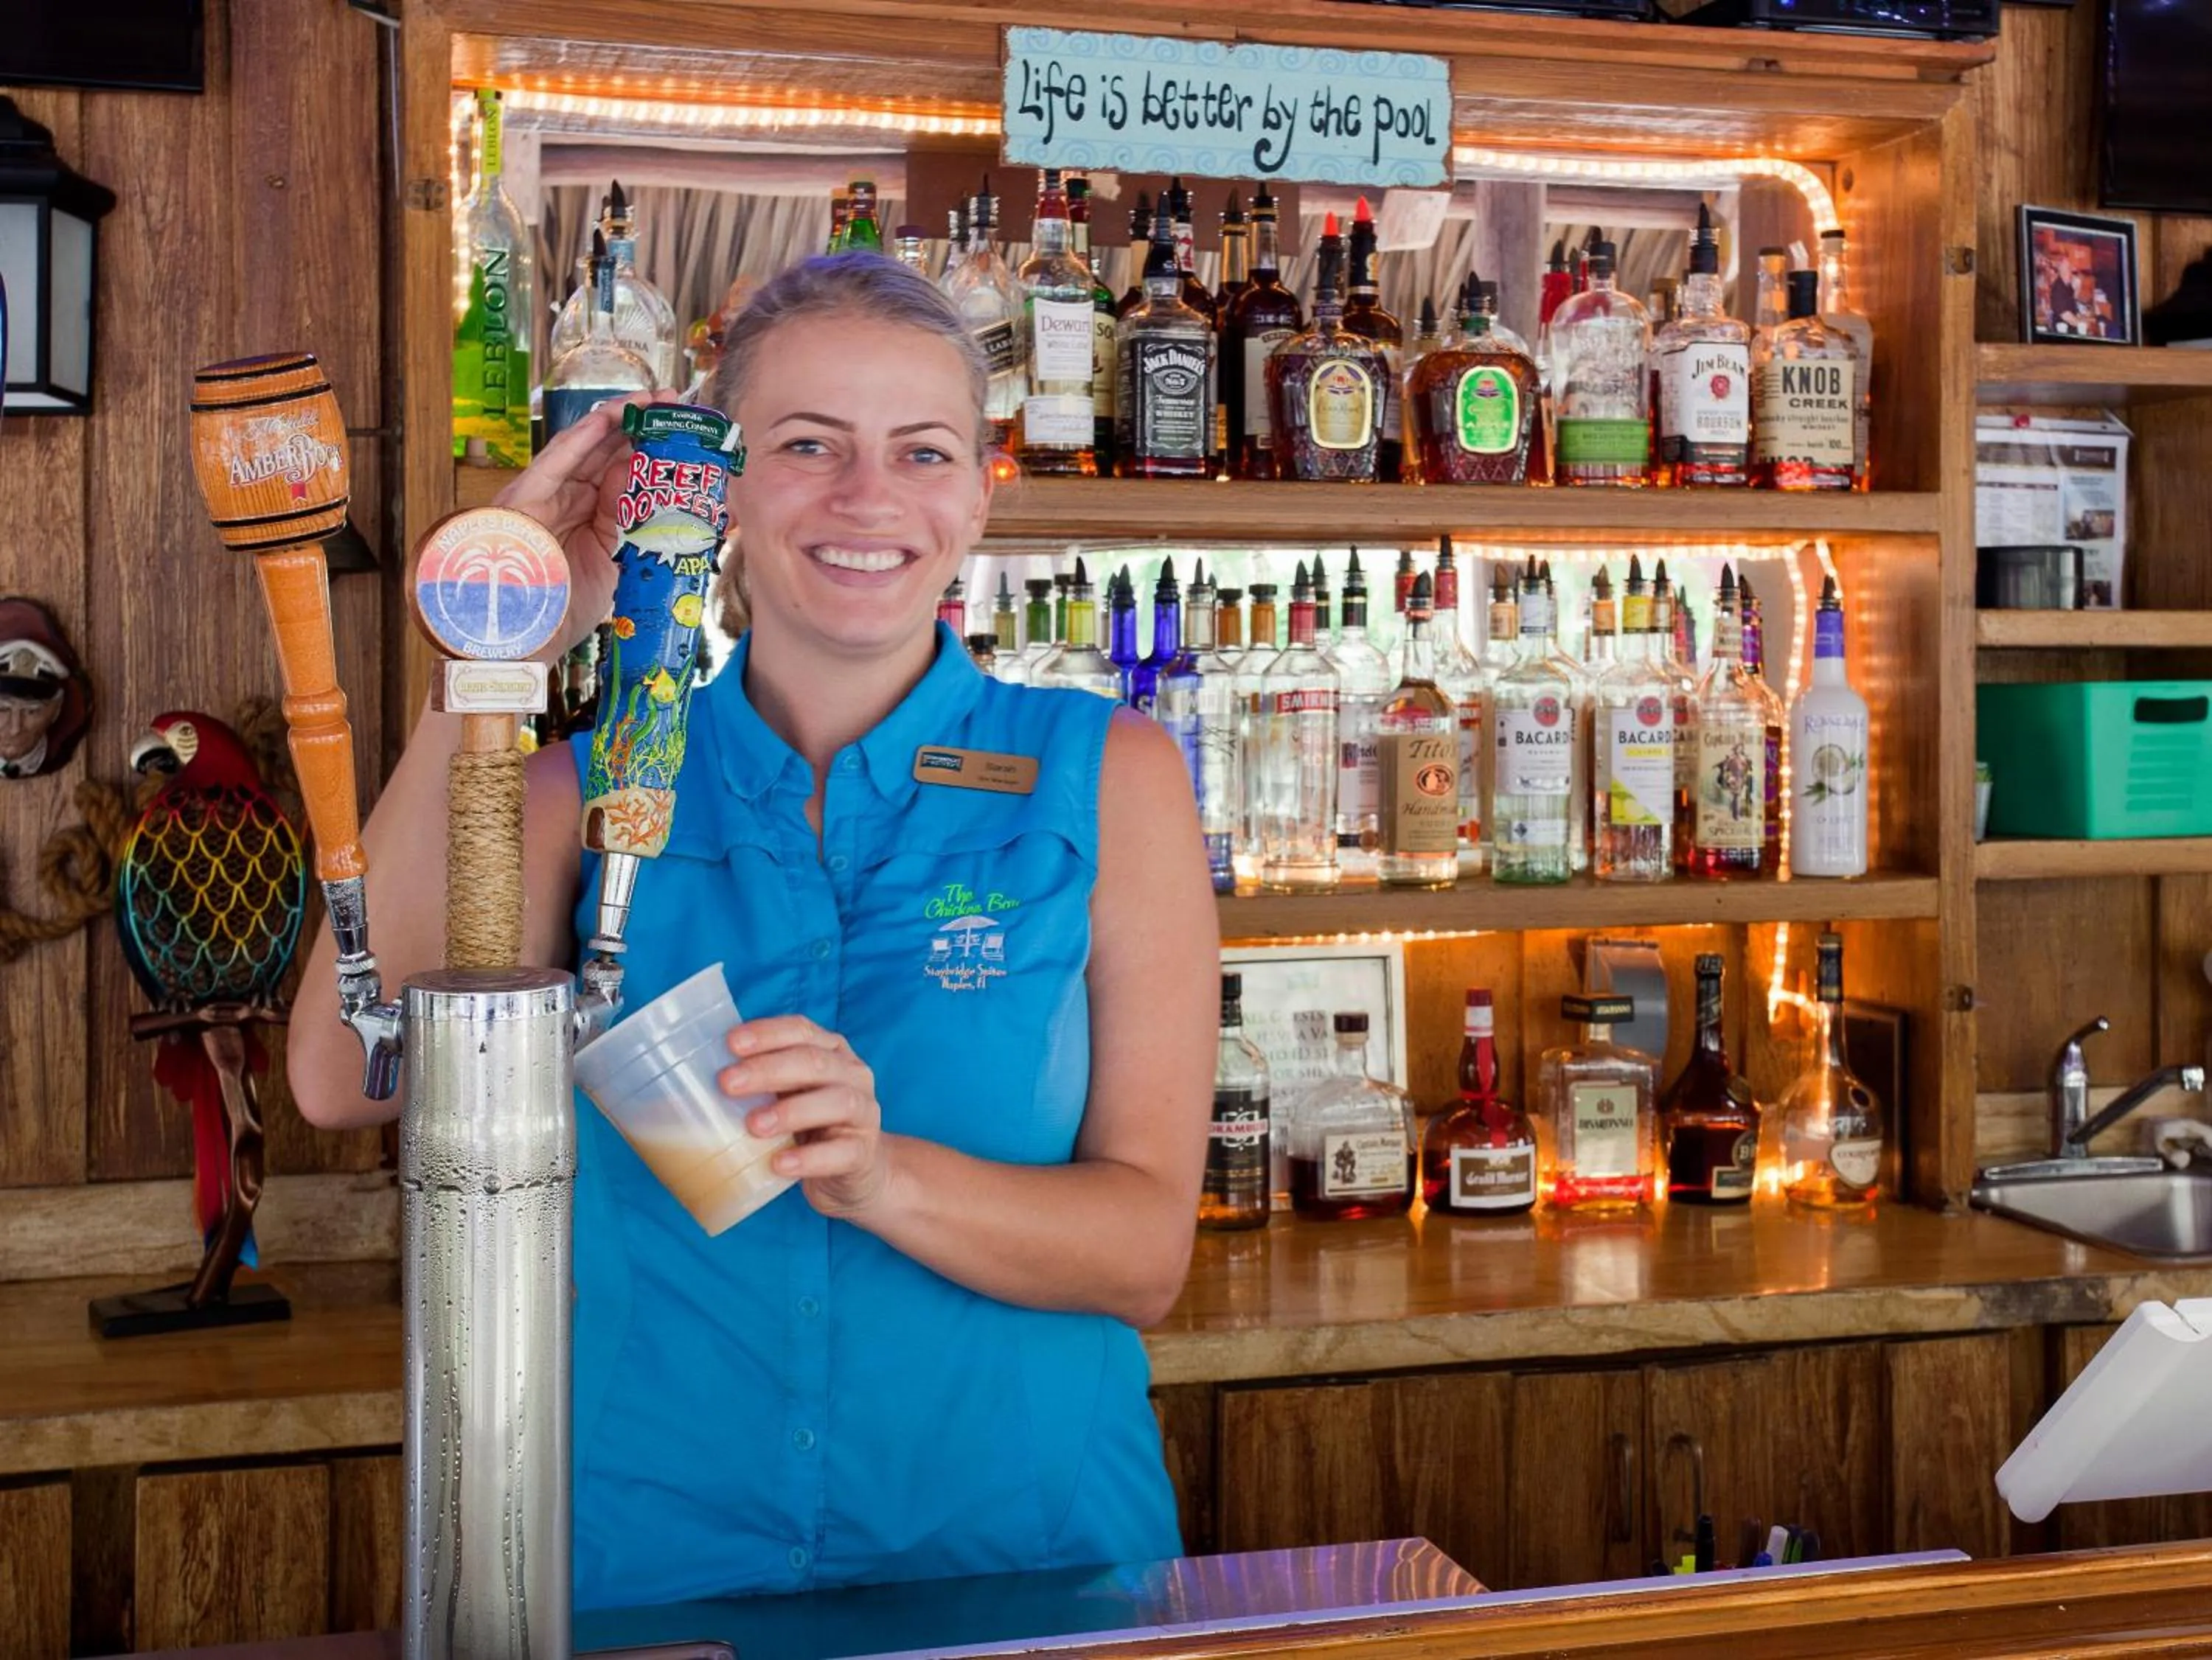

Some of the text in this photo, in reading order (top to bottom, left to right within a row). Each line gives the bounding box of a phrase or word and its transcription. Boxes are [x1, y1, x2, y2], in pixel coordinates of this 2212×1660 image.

[1018, 59, 1086, 144] Life
[1102, 74, 1128, 130] is
[1142, 71, 1252, 133] better
[1253, 83, 1298, 172] by
[1311, 85, 1362, 138] the
[484, 248, 509, 418] LEBLON
[1040, 315, 1090, 332] Dewar
[1143, 353, 1168, 374] JACK
[1691, 358, 1714, 379] JIM
[1782, 366, 1840, 394] KNOB
[1789, 398, 1848, 409] CREEK
[627, 451, 722, 495] REEF
[617, 489, 726, 530] DONKEY
[674, 556, 712, 575] APA
[462, 640, 522, 658] BREWERY
[1514, 730, 1569, 744] BACARD
[1618, 730, 1672, 744] BACARD
[944, 884, 973, 903] The
